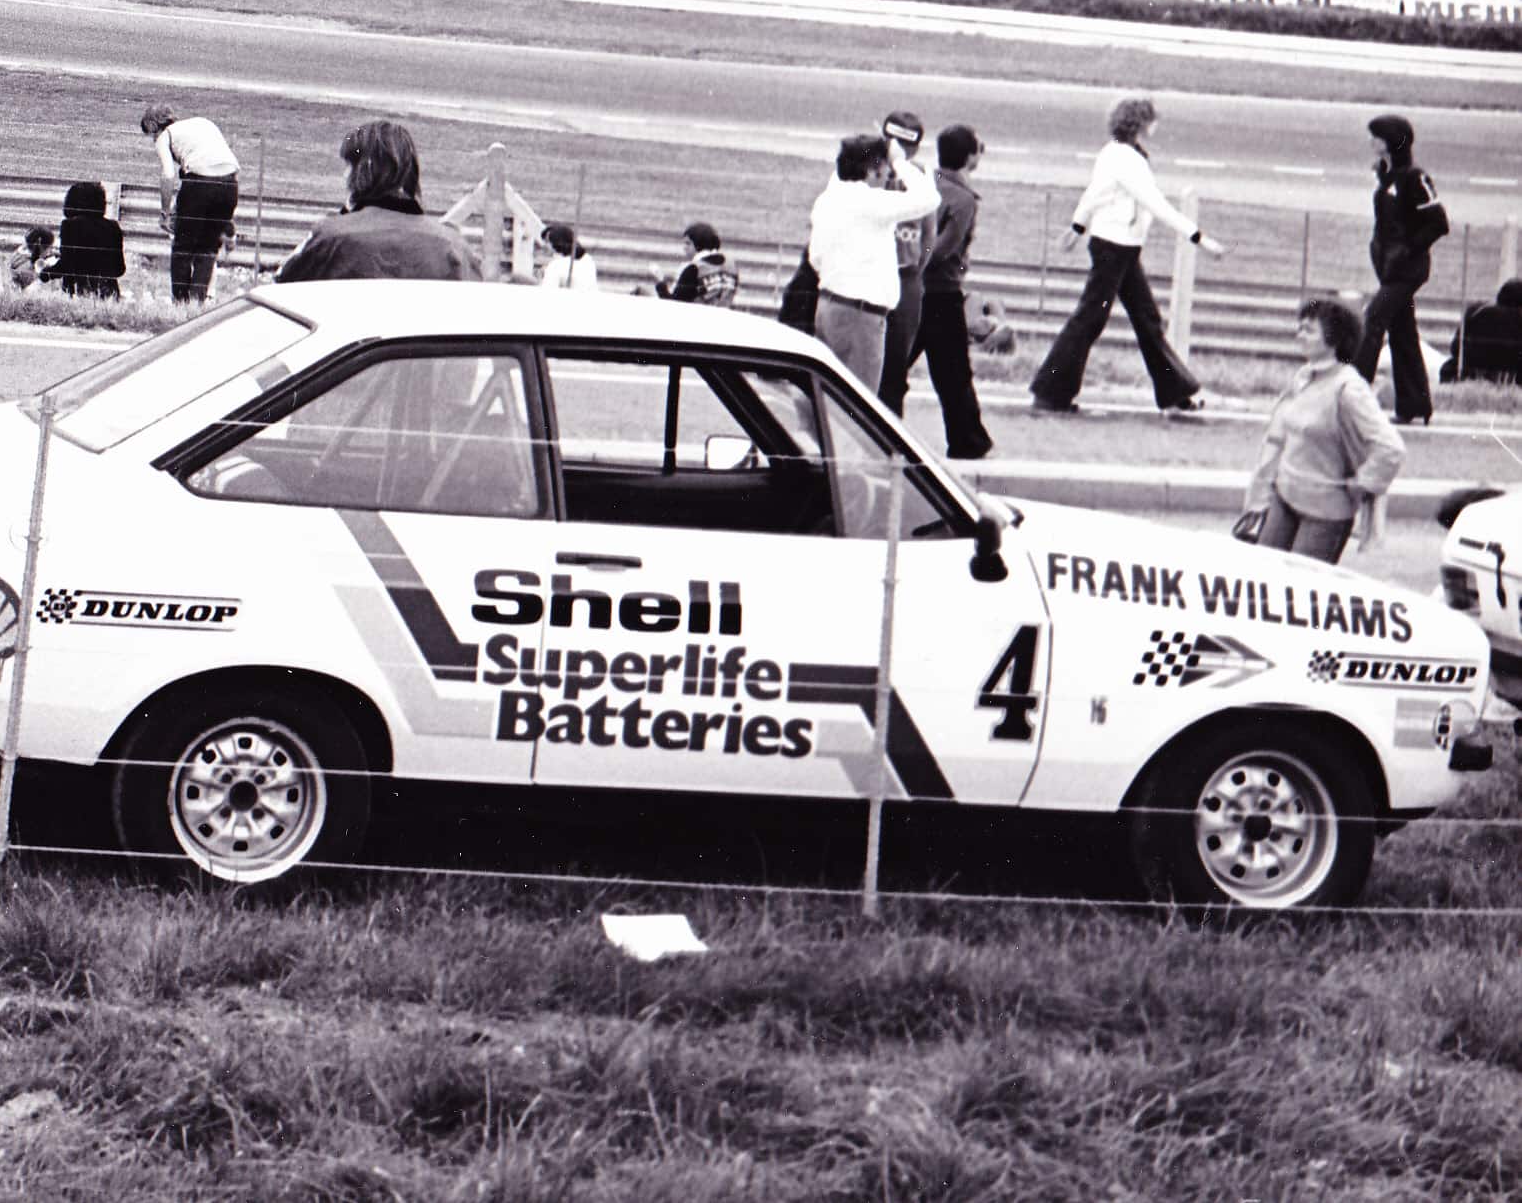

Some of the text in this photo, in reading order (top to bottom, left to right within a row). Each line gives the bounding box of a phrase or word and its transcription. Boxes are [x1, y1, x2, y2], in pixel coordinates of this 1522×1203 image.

[80, 599, 239, 623] DUNLOP
[471, 568, 743, 636] Shell
[1047, 552, 1413, 643] FRANK WILLIAMS
[482, 633, 783, 699] Superlife
[974, 623, 1043, 742] 4
[1343, 659, 1478, 685] DUNLOP
[496, 689, 814, 758] Batteries
